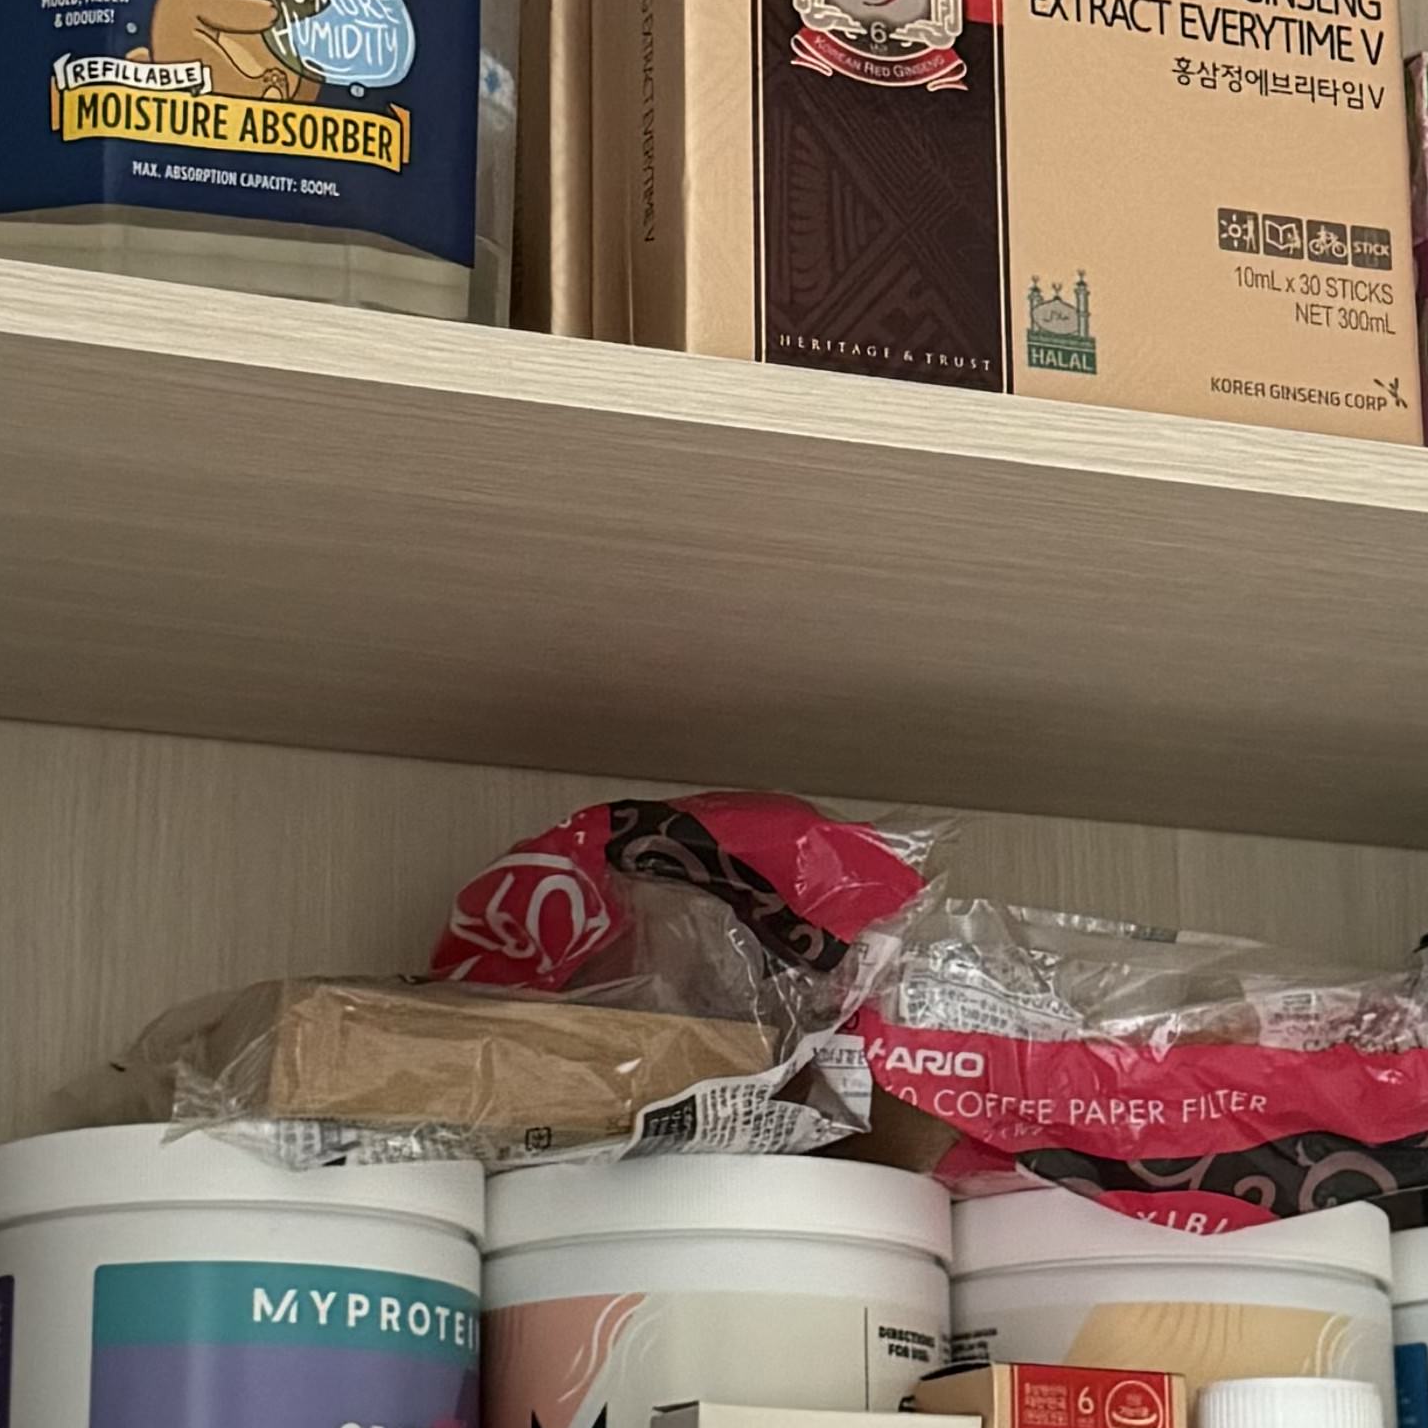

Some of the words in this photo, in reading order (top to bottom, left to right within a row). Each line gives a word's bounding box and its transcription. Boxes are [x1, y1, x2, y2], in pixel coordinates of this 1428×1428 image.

[65, 9, 115, 26] ODOURS!
[871, 22, 887, 44] 6
[272, 3, 398, 65] HUMIDITY
[1181, 2, 1355, 63] EVERYTIME
[1360, 28, 1384, 66] V
[73, 61, 197, 87] REFILLABLE
[863, 61, 891, 77] RED
[77, 92, 228, 141] MOISTURE
[239, 107, 393, 163] ABSORBER
[132, 160, 162, 179] MAX.
[165, 164, 237, 186] ABSORPTION
[240, 174, 297, 194] CAPACITY:
[300, 180, 340, 197] 800ML
[1352, 239, 1390, 258] STICK
[1234, 266, 1281, 293] 10mL
[1300, 275, 1322, 297] 30
[1325, 278, 1394, 305] STICKS
[1295, 303, 1332, 327] NET
[1337, 308, 1396, 335] 300mL
[779, 334, 891, 360] HERITAGE
[902, 350, 914, 363] &
[925, 352, 993, 372] TRUST
[1030, 348, 1095, 373] HALAL
[1211, 378, 1265, 401] KOREA
[1270, 384, 1341, 407] GINSENG
[1344, 392, 1387, 411] CORP
[934, 1090, 1053, 1124] COFFEE
[1070, 1098, 1164, 1126] PAPER
[1183, 1089, 1267, 1122] FILTER
[1078, 1386, 1094, 1414] 6
